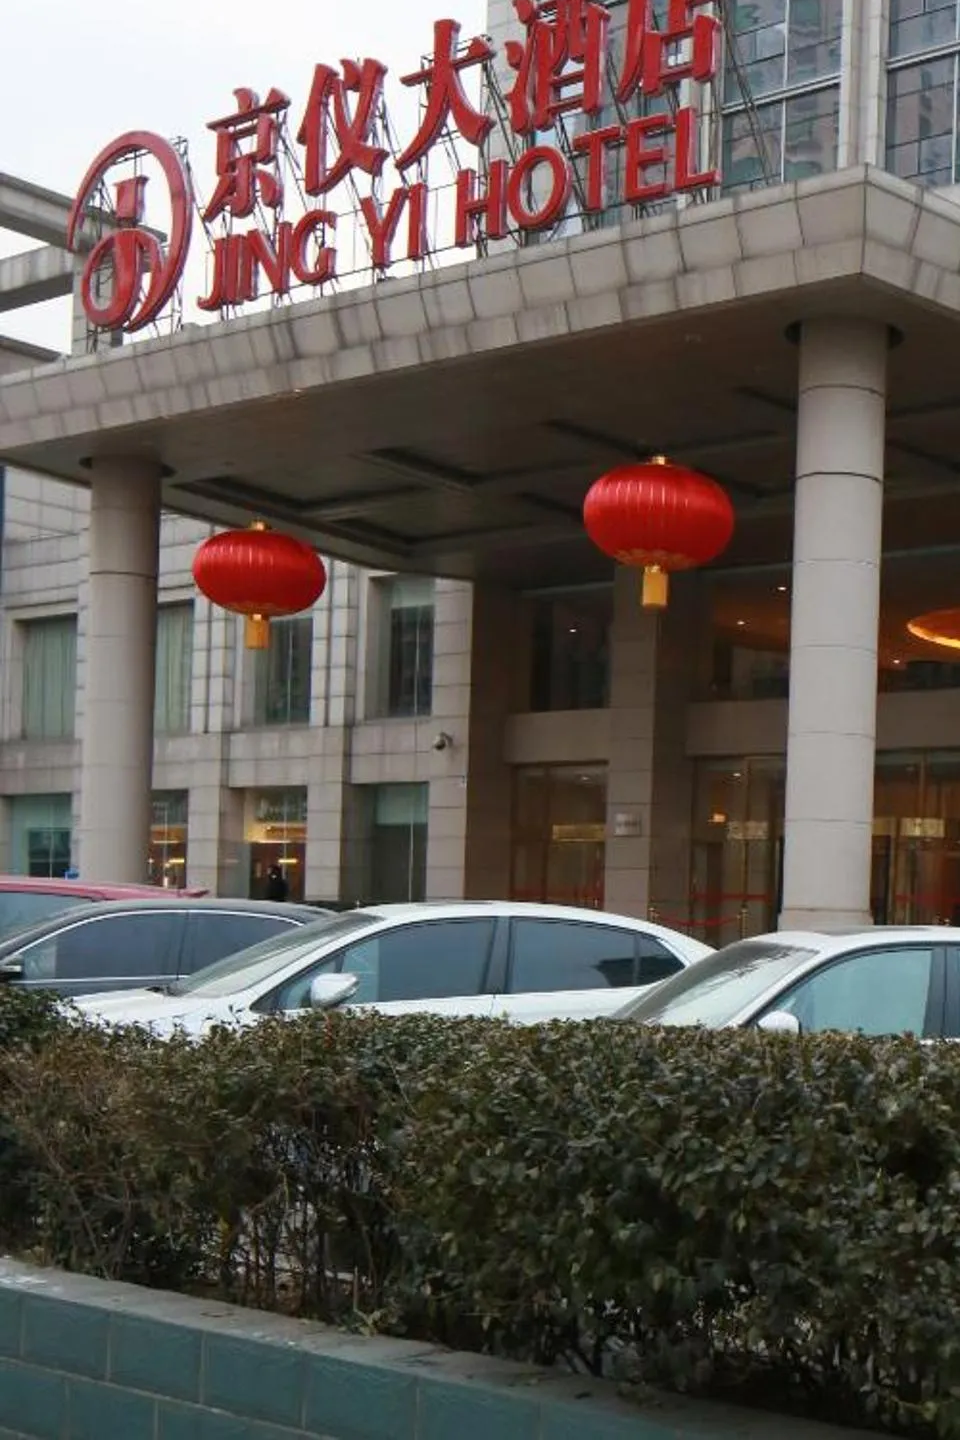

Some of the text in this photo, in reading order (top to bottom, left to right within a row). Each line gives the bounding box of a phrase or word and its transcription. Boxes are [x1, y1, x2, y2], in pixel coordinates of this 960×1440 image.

[197, 108, 721, 311] JING YI HOTEL
